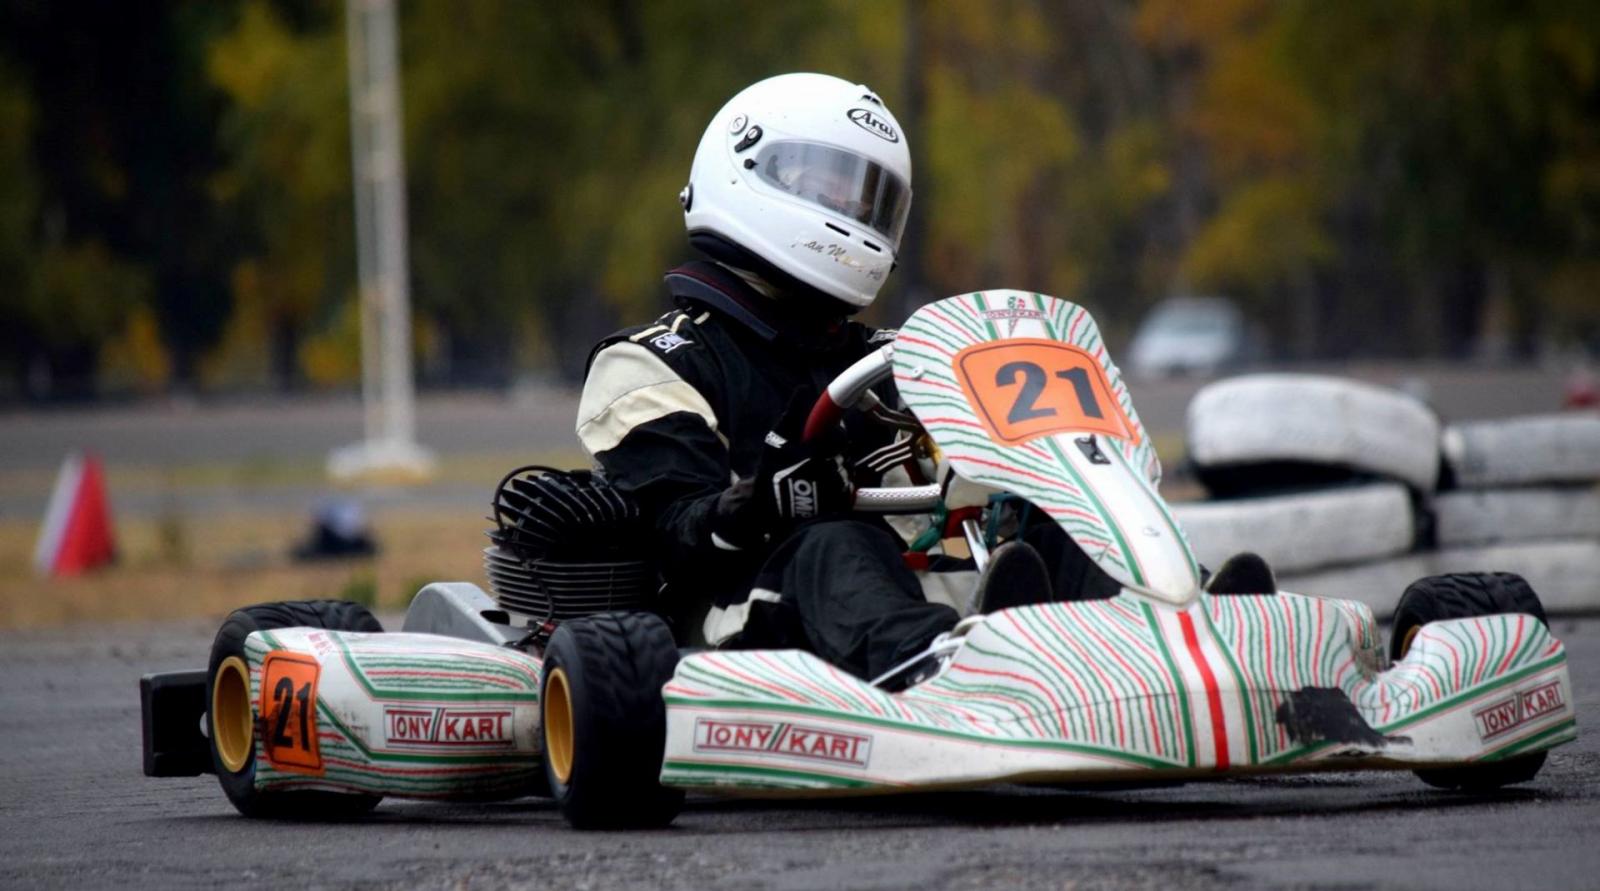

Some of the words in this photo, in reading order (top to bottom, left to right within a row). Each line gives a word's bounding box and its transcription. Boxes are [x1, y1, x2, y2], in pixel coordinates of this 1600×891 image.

[851, 111, 894, 138] Arai
[995, 361, 1104, 425] 21
[274, 677, 311, 752] 21
[386, 709, 432, 739] TONY
[445, 711, 512, 741] KART
[1475, 699, 1516, 734] TONY
[1523, 681, 1563, 718] KART
[700, 720, 773, 748] TONY
[791, 727, 868, 761] KART
